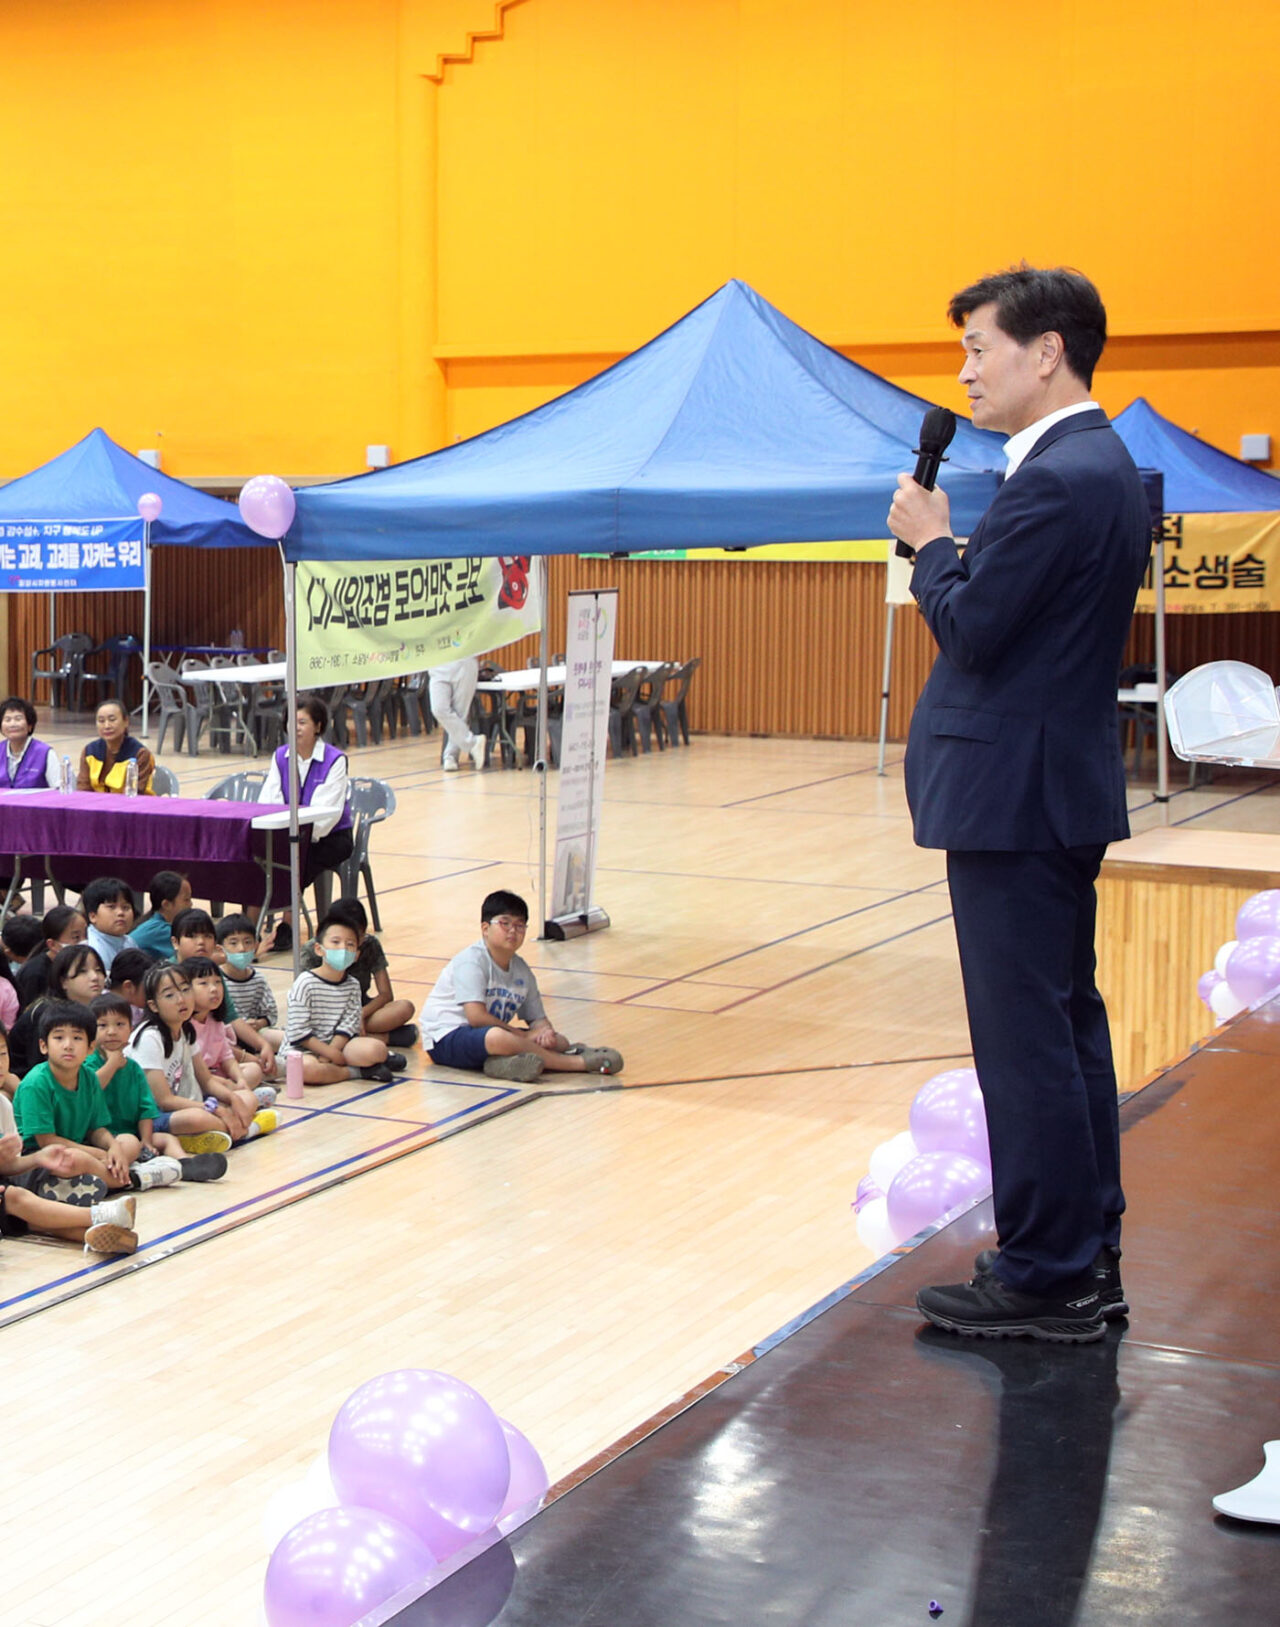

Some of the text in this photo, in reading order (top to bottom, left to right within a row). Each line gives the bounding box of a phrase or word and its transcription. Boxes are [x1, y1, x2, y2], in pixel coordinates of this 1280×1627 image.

[18, 543, 44, 571] 고래,
[46, 542, 80, 570] 고래를
[81, 542, 117, 568] 지키는
[118, 539, 142, 568] 우리
[1140, 553, 1266, 591] 소생술
